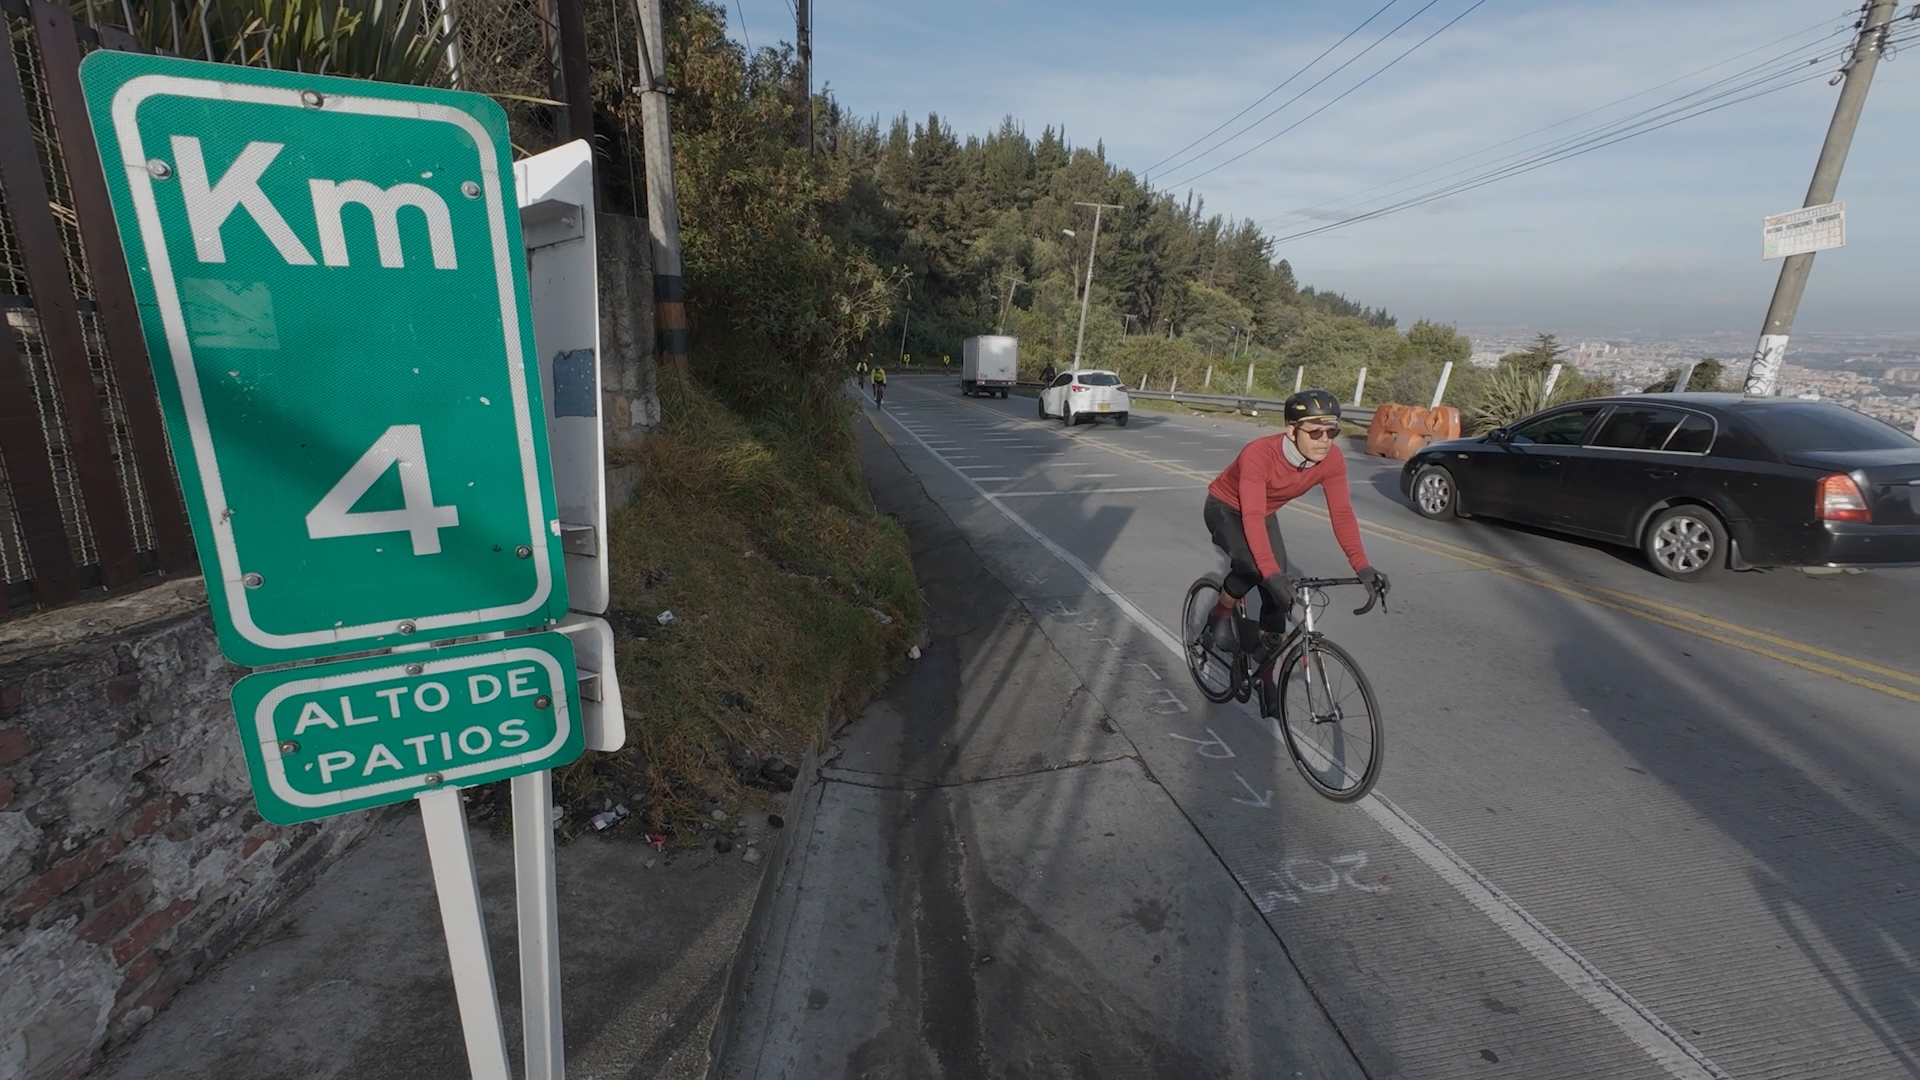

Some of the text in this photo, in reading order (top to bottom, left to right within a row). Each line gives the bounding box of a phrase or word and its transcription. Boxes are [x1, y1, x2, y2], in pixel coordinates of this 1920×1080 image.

[171, 134, 459, 271] Km
[305, 424, 459, 556] 4
[294, 667, 539, 735] ALTO DE
[318, 718, 531, 785] PATIOS
